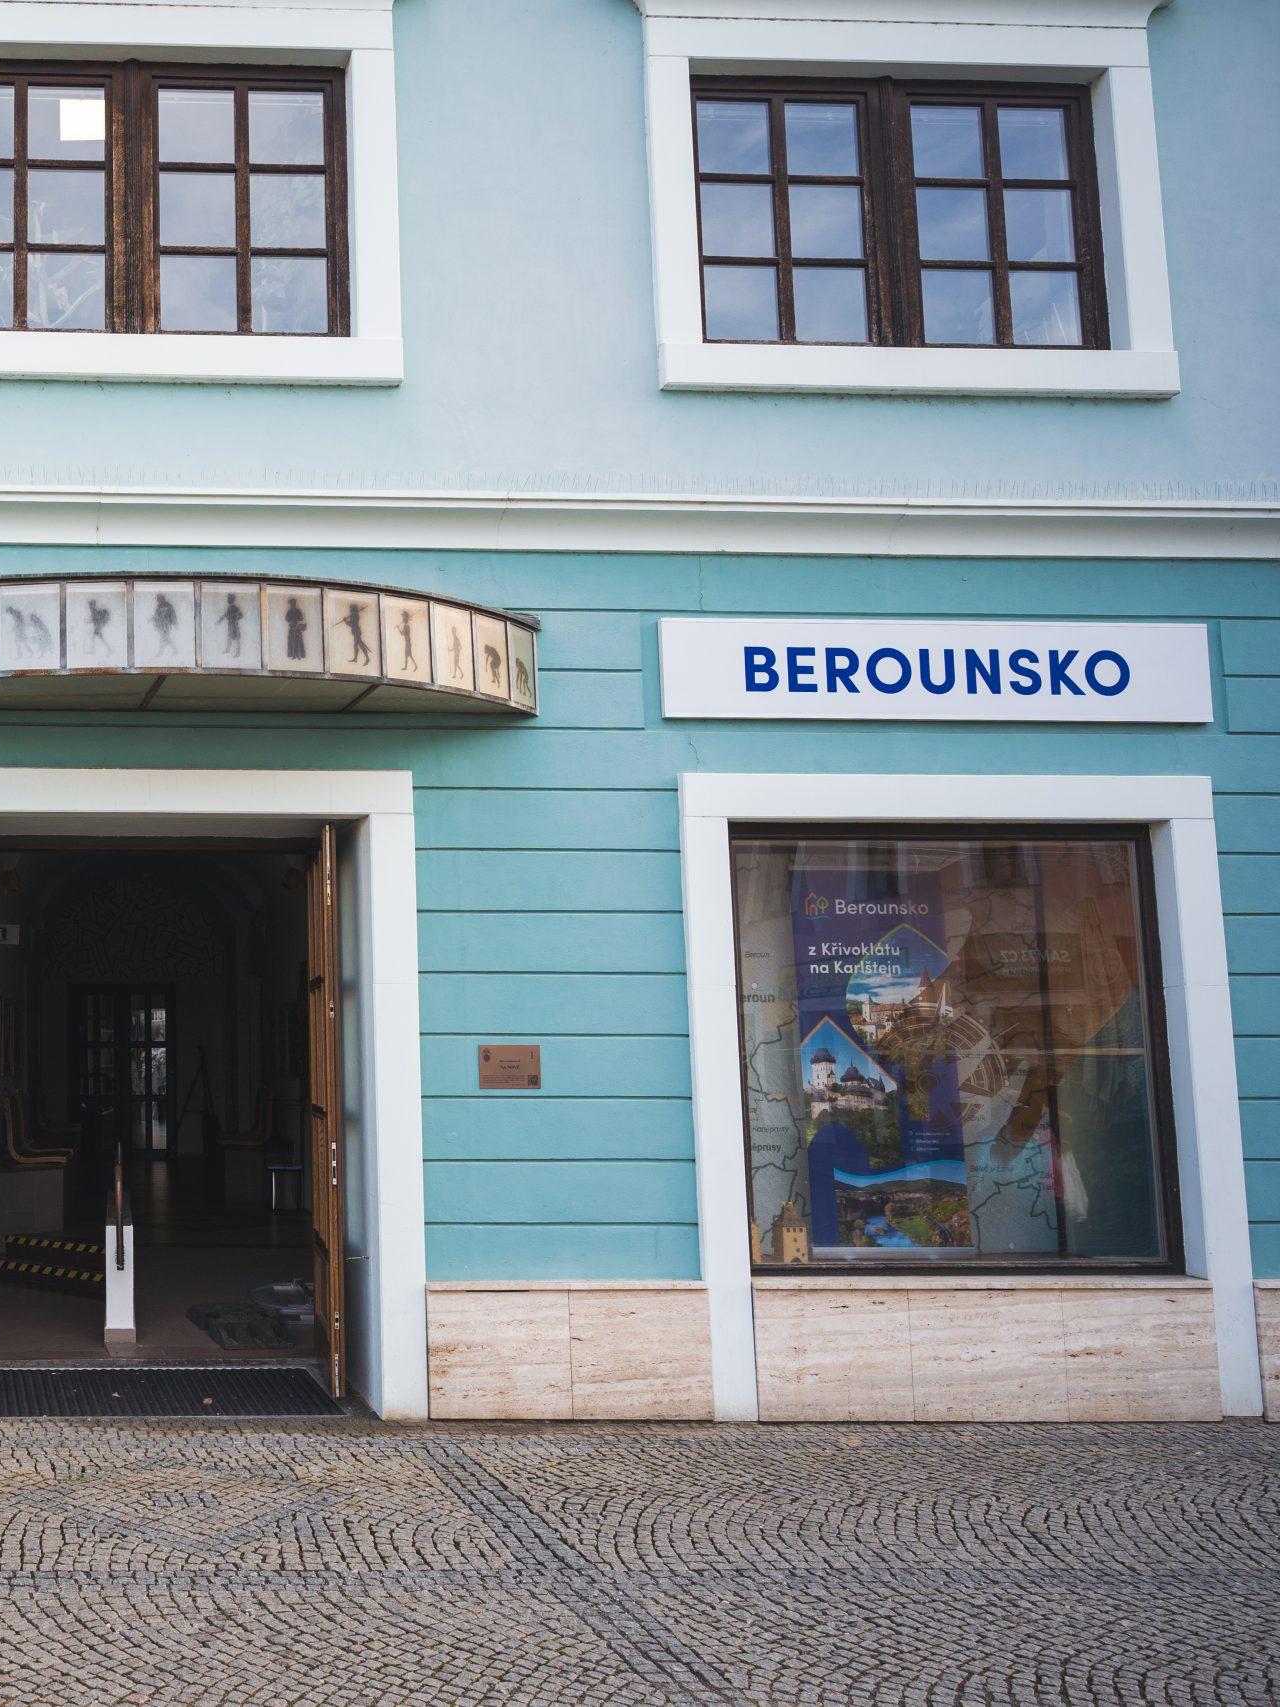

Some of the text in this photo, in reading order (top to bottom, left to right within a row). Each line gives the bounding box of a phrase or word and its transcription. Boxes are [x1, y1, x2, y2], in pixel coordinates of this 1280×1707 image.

[743, 645, 1131, 697] BEROUNSKO
[834, 899, 929, 916] Berounsko
[808, 941, 901, 957] z Křivoklátu
[810, 961, 902, 977] na Karlštejn
